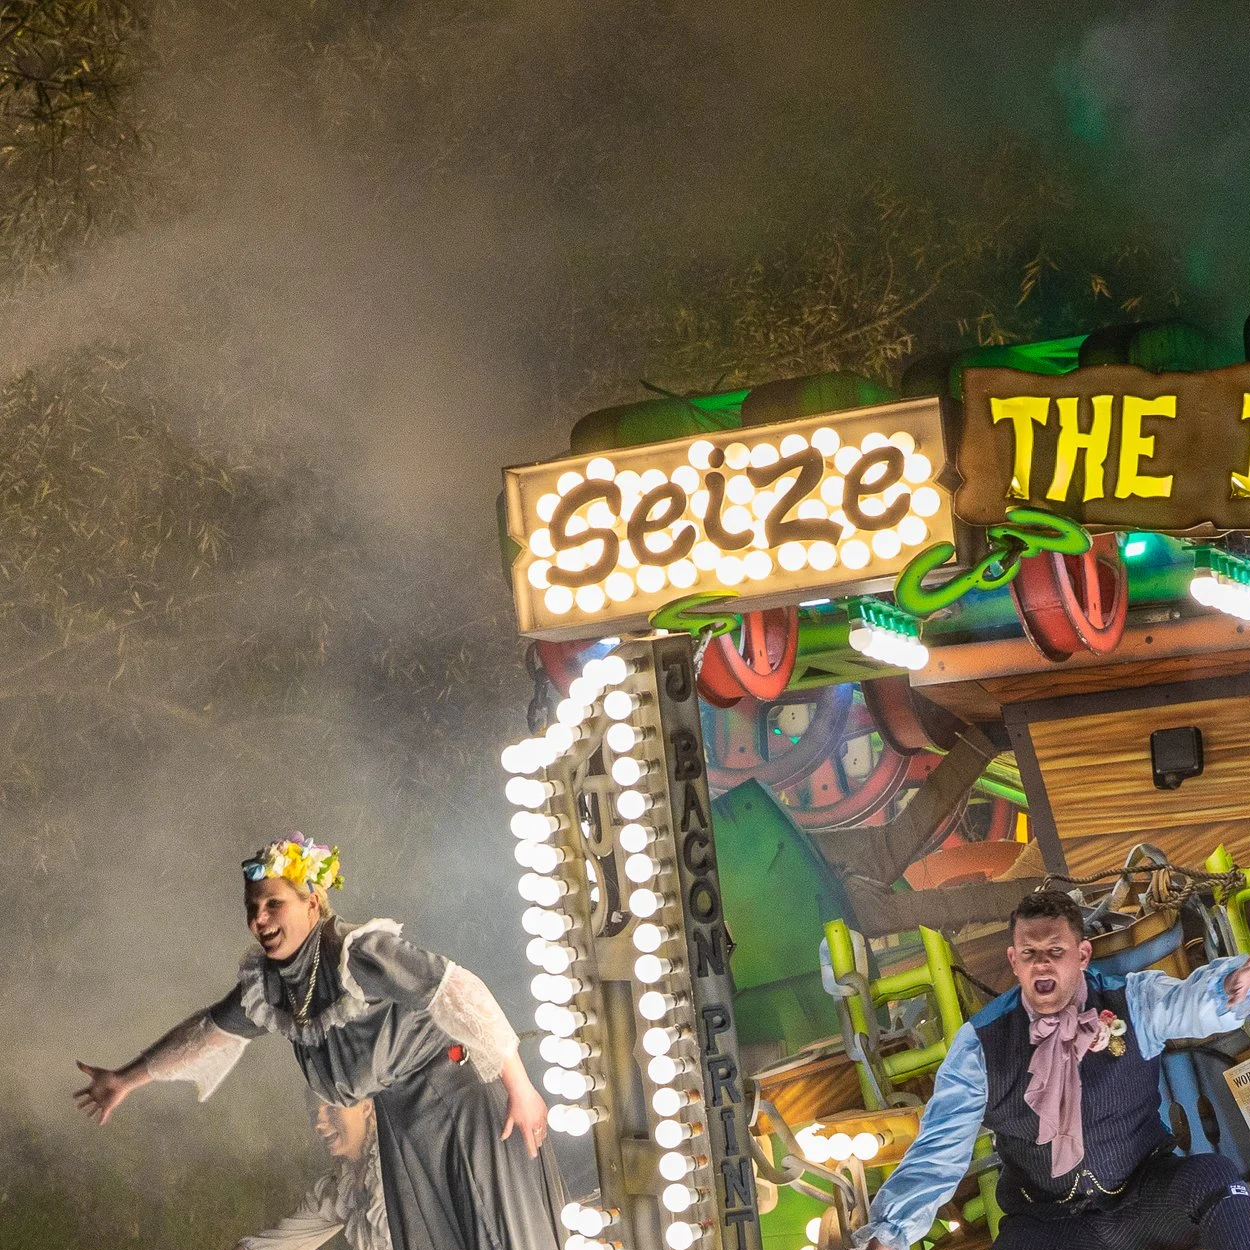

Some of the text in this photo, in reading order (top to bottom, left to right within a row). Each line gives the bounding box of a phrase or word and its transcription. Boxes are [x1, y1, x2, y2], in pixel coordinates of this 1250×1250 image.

[990, 394, 1177, 502] THE
[662, 660, 692, 702] J
[670, 731, 721, 978] BACON
